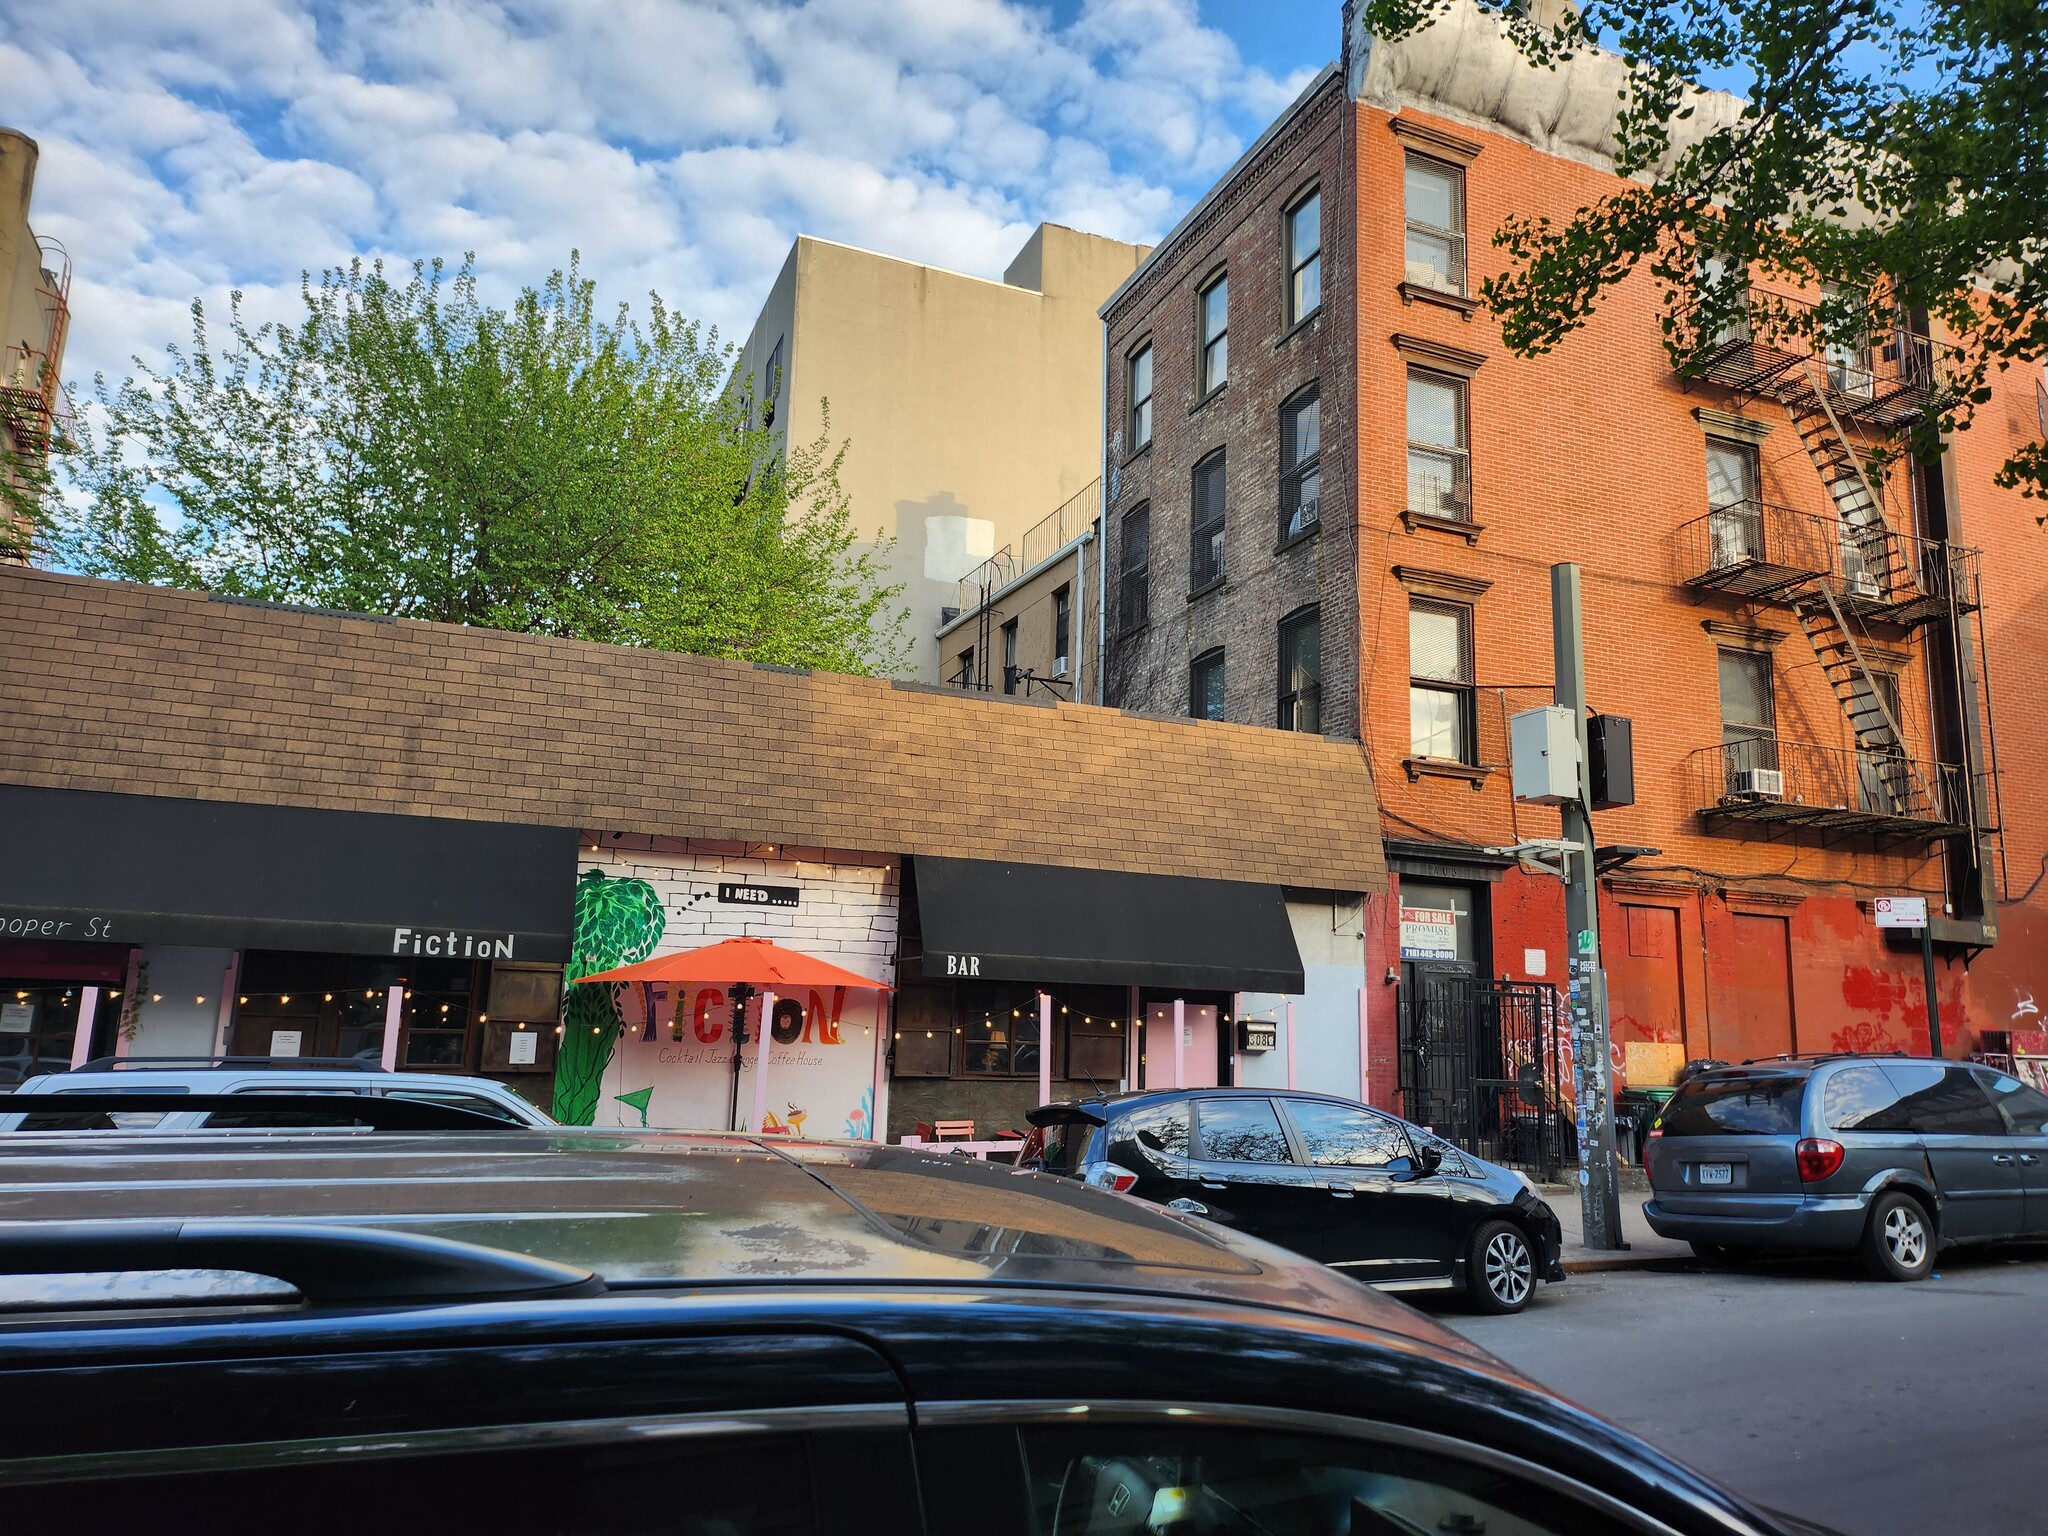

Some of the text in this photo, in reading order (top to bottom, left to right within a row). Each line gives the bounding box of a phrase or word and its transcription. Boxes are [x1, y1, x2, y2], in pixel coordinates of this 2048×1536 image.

[725, 887, 730, 898] I
[734, 888, 769, 902] NEED
[1414, 911, 1451, 924] FOR SALE
[84, 917, 112, 938] St
[1405, 923, 1450, 936] PROMISE
[946, 955, 980, 976] BAR
[638, 981, 845, 1045] FictoN
[1249, 1033, 1267, 1047] 308
[658, 1047, 704, 1064] Cocktail
[705, 1048, 728, 1064] Jazz
[796, 1051, 823, 1066] House
